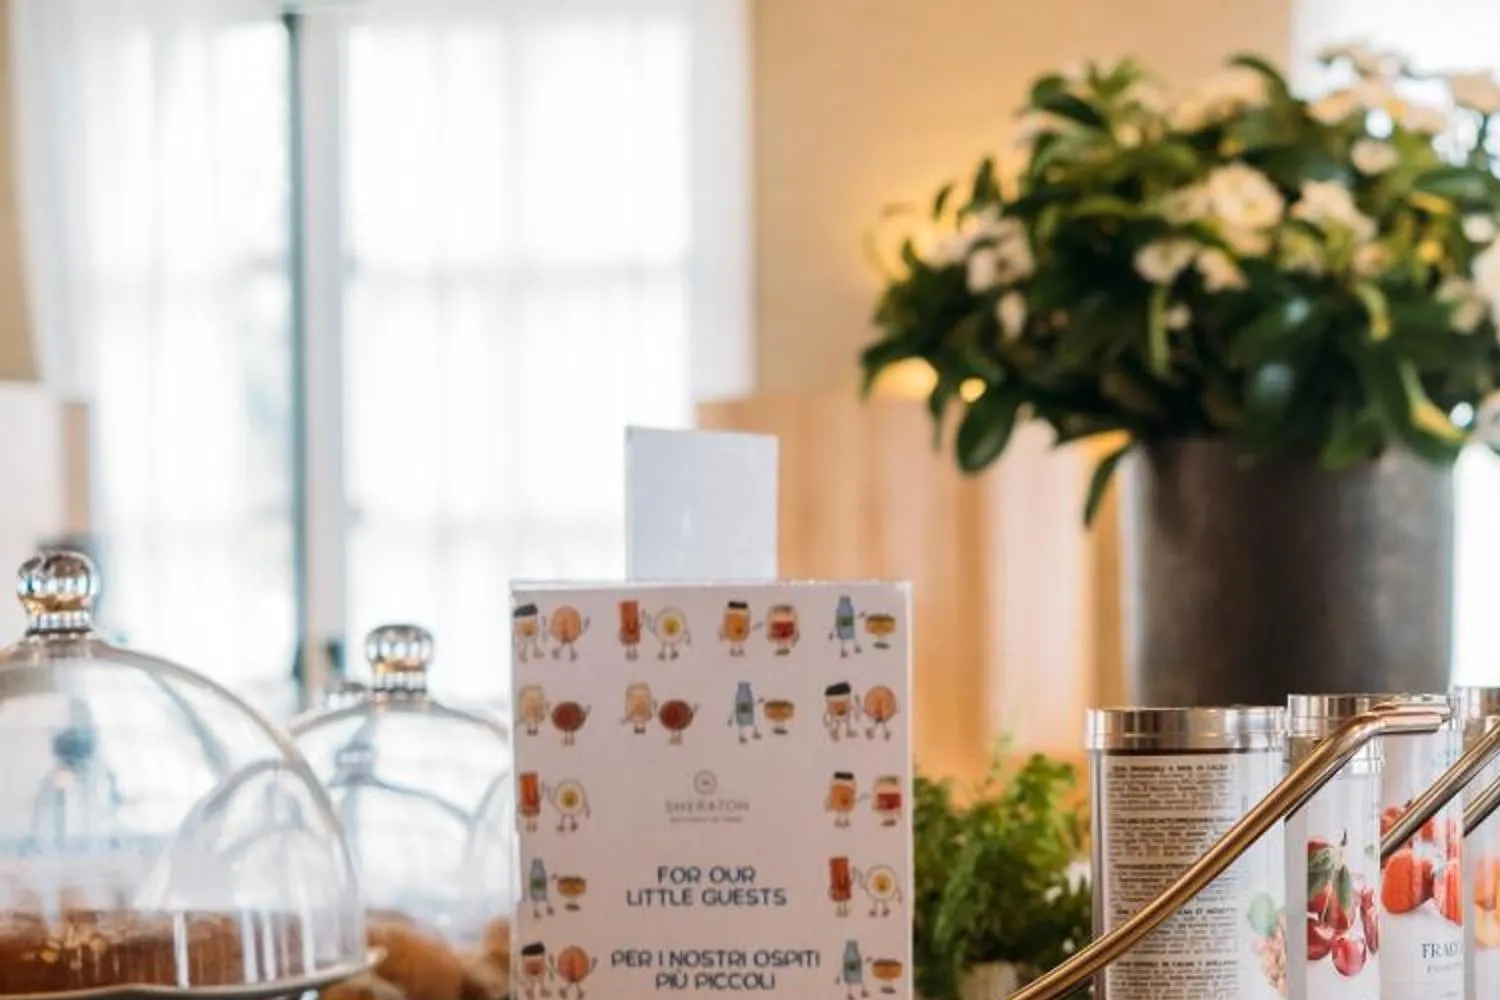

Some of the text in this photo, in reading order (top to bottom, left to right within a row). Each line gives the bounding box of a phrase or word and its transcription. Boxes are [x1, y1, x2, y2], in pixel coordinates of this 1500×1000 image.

[657, 866, 756, 884] FOR OUR
[626, 888, 787, 906] LITTLE GUESTS
[611, 950, 821, 967] PER I NOSTRI OSPITI
[655, 968, 775, 991] PIÙ PICCOLI
